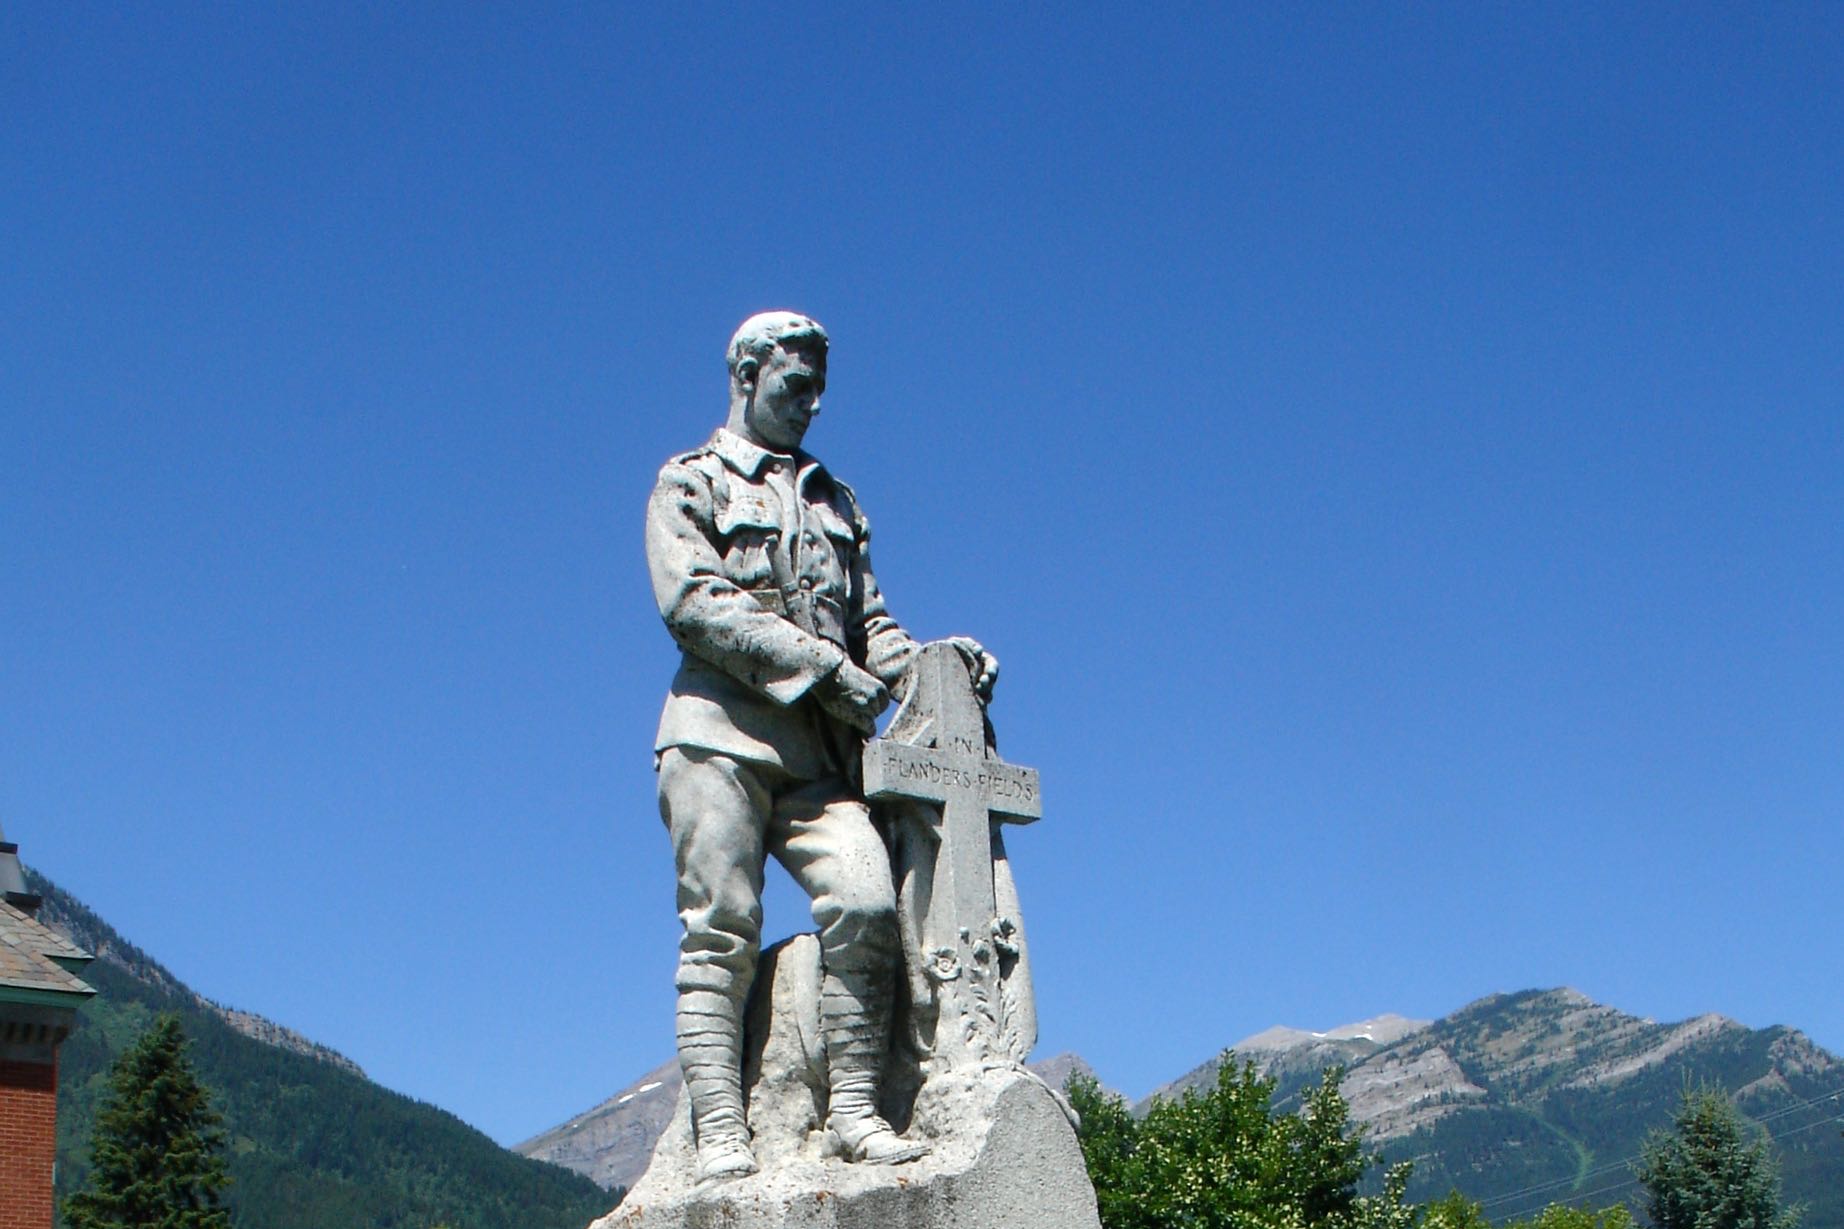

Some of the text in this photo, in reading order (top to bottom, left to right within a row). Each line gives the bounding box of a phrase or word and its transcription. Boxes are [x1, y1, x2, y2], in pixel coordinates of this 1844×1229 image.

[954, 736, 973, 756] IN
[888, 757, 1034, 802] FLANDERS FIELDS
